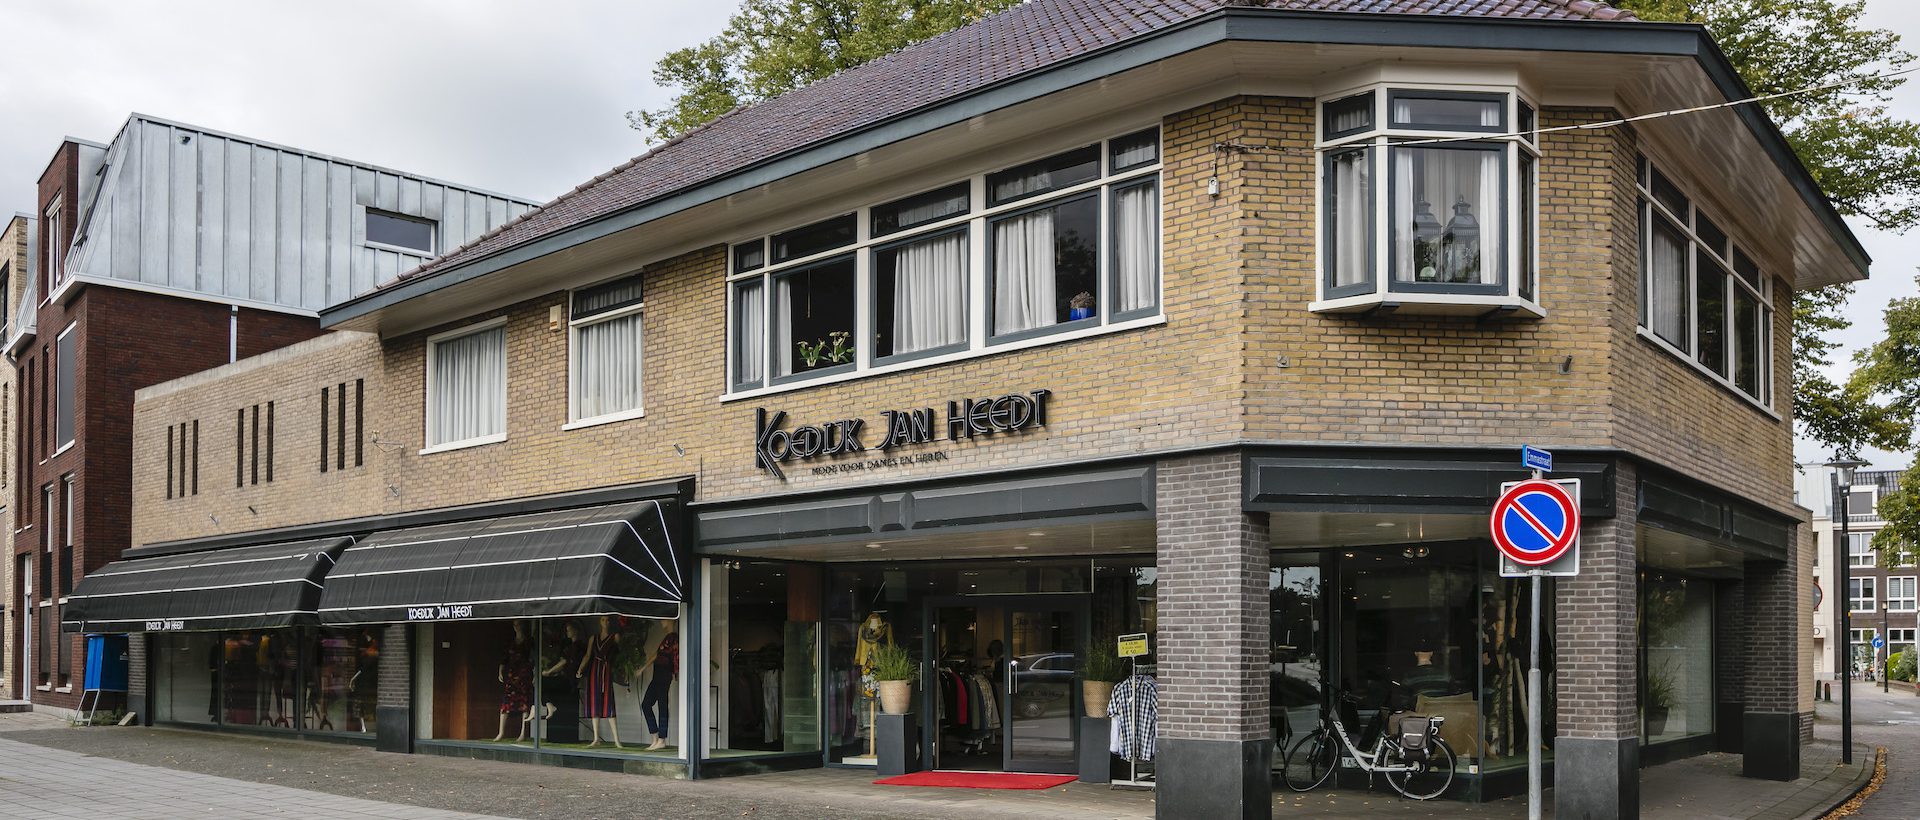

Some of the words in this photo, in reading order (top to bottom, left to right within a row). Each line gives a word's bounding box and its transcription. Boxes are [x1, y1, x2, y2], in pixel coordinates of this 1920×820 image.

[755, 407, 865, 480] KOEDIJK
[875, 407, 934, 451] JAN
[947, 388, 1052, 441] HEEDT
[812, 464, 838, 476] MODE
[840, 462, 865, 473] VOOR
[867, 458, 898, 470] DAMES
[900, 456, 913, 465] EN
[915, 451, 948, 464] HEREN
[437, 606, 450, 619] JAN
[451, 605, 473, 618] HEEDT
